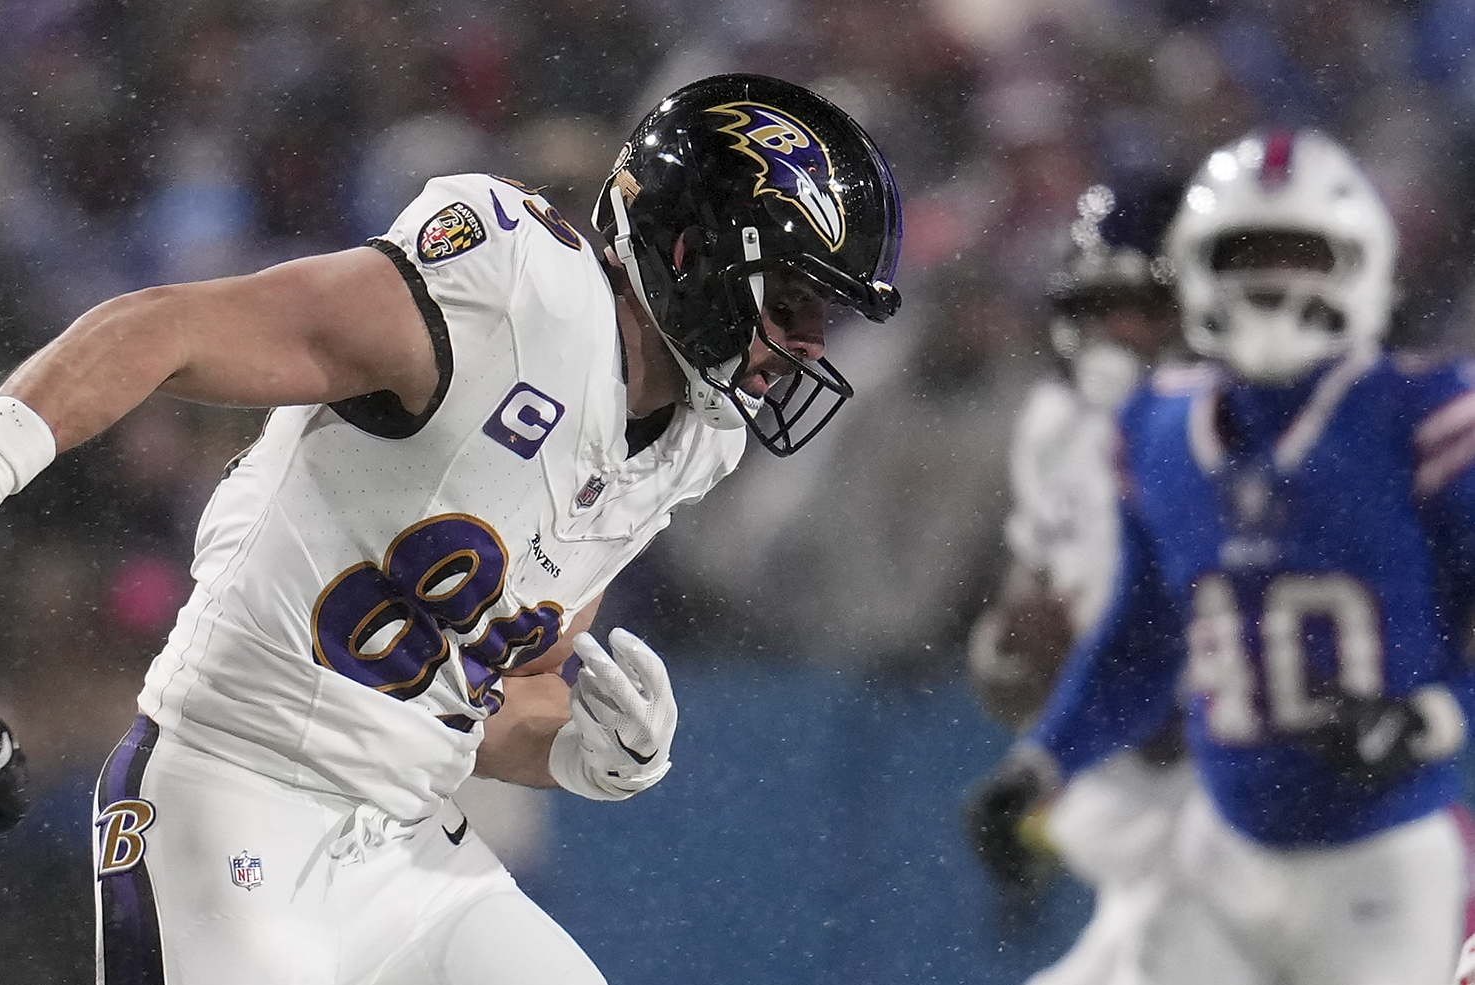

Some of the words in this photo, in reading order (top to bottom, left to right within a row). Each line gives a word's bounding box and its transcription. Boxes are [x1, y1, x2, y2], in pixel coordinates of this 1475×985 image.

[745, 109, 810, 155] B
[453, 203, 483, 239] RAVENS
[500, 390, 558, 441] C
[530, 533, 562, 579] RAVENS
[94, 797, 157, 883] B
[237, 867, 260, 883] NFL
